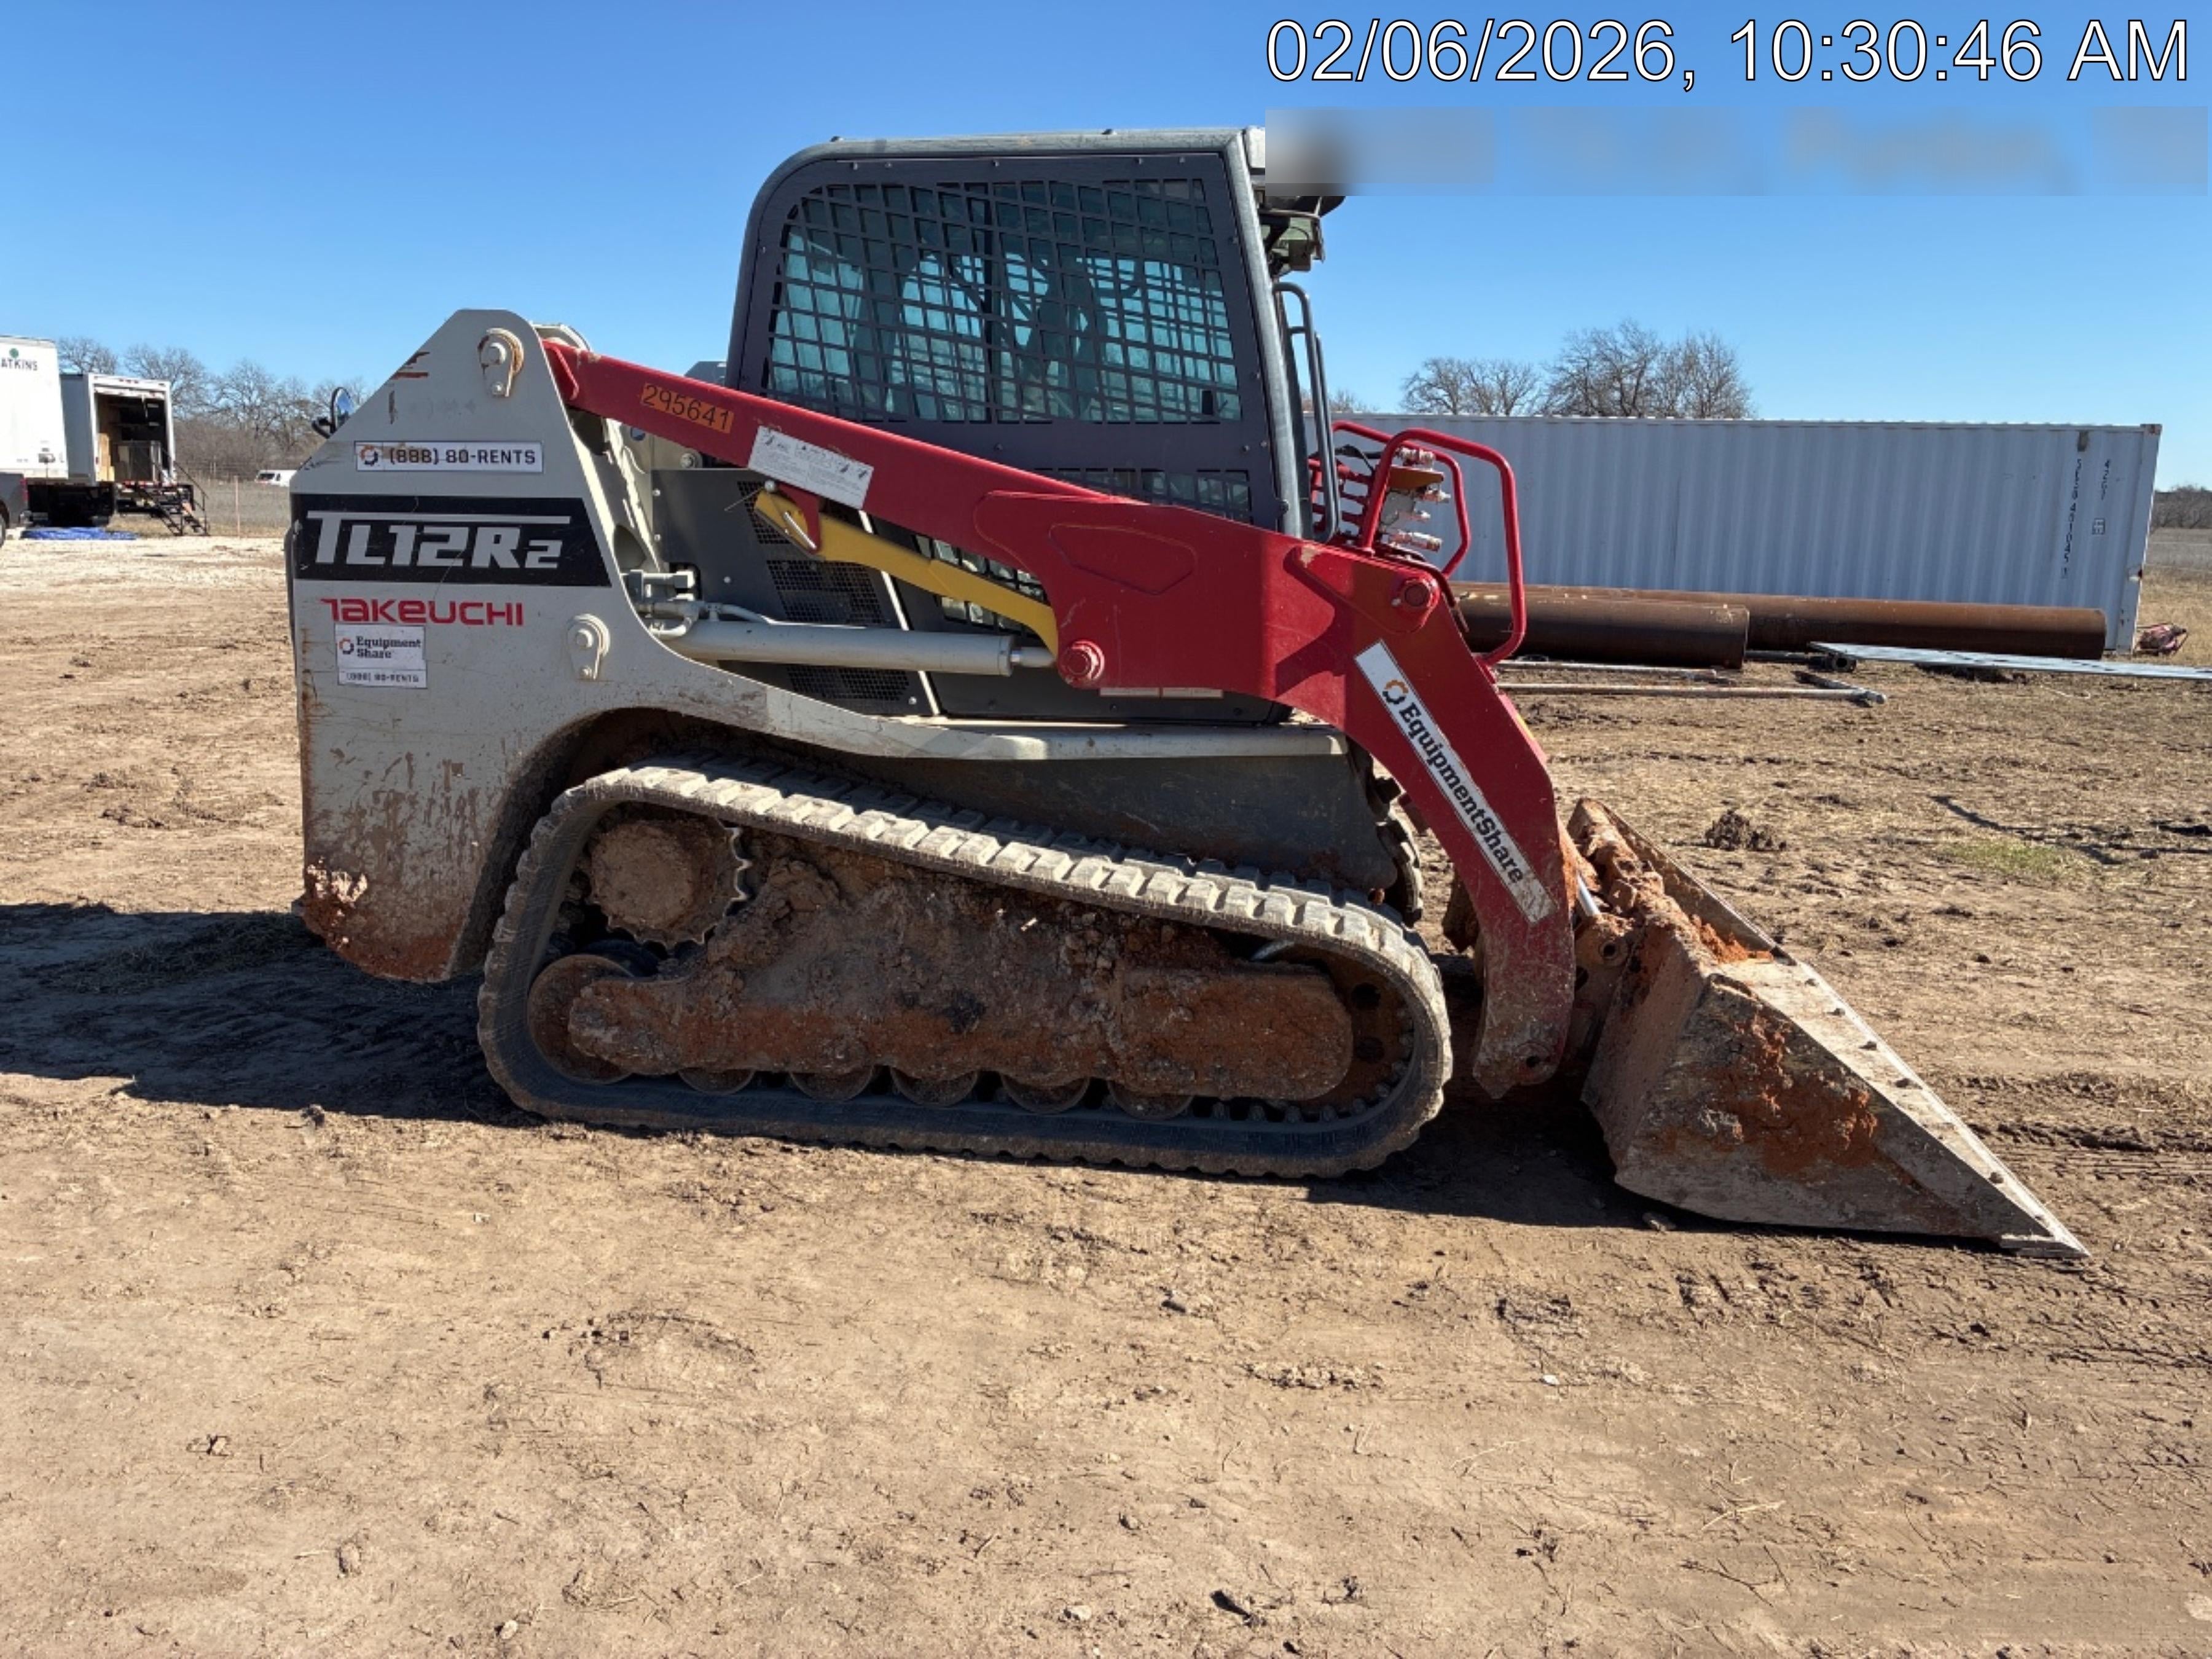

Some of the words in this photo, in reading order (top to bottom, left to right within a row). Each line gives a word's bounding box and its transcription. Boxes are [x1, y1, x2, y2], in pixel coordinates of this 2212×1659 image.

[643, 384, 731, 431] 295641
[445, 449, 536, 465] 80-RENTS
[307, 510, 571, 569] TL12R2
[356, 635, 422, 649] Equipment
[356, 648, 391, 659] Share
[1399, 702, 1524, 884] EquipmentShare
